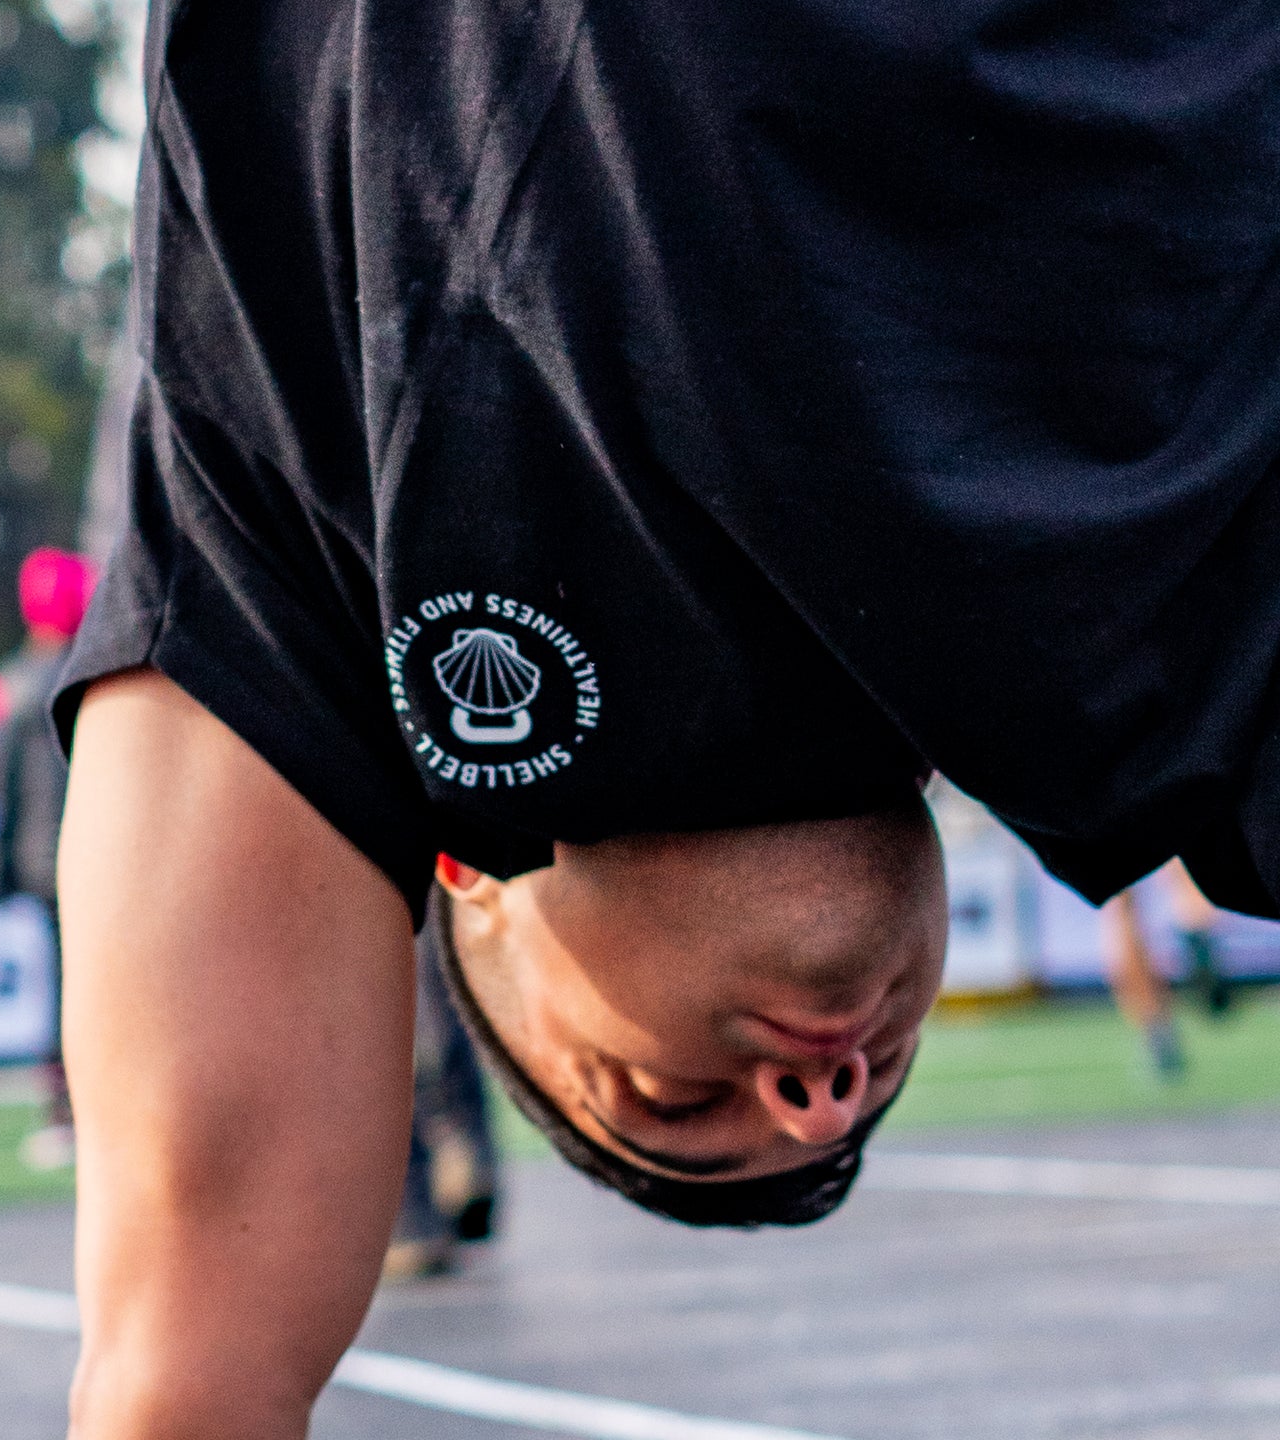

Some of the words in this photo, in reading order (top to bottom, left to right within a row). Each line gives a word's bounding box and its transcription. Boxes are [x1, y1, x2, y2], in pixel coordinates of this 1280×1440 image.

[419, 590, 475, 621] AND
[484, 592, 602, 729] HEALTHINESS
[415, 732, 573, 789] SHELLBELL
